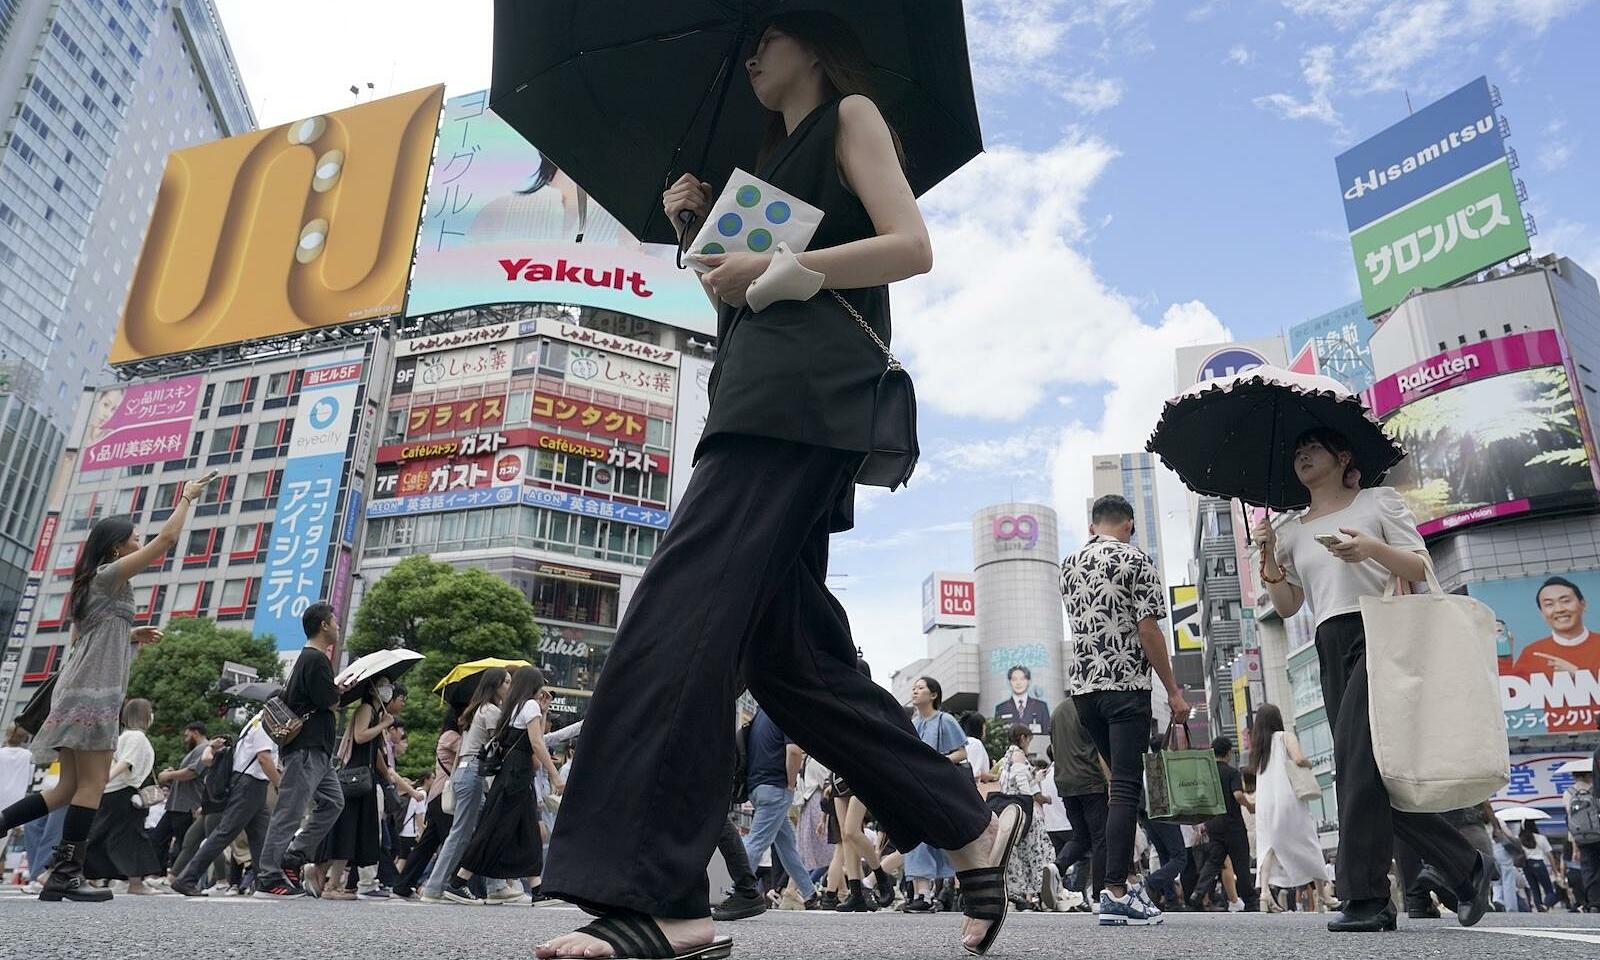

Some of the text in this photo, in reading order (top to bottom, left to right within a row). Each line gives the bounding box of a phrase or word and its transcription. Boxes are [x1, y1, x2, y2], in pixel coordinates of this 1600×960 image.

[434, 89, 487, 252] ヨーグルト
[1344, 115, 1494, 199] Hisamitsu
[1364, 193, 1511, 286] サロンパス
[498, 258, 653, 297] Yakult
[561, 324, 674, 362] しゃぶしゃぶバイキング
[397, 368, 415, 383] 9F
[449, 350, 507, 376] しゃぶ葉
[605, 360, 671, 392] しゃぶ葉
[1397, 354, 1480, 393] Rakuten
[141, 384, 196, 404] 品川スキン
[138, 400, 186, 419] クリニック
[410, 400, 502, 430] プライス
[532, 395, 642, 435] コンタクト
[96, 434, 182, 462] 品川美容外科
[459, 432, 508, 456] ガスト
[607, 447, 658, 472] ガスト
[377, 474, 399, 492] 7F
[428, 462, 488, 493] ガスト
[407, 492, 492, 512] 英会話イーオン
[527, 489, 562, 504] AEON
[569, 496, 667, 524] 英会話イーオン
[992, 514, 1039, 550] 109
[267, 481, 312, 619] アイシティ
[291, 478, 332, 618] コンタクトの
[944, 584, 969, 598] UNI
[944, 599, 972, 613] QLO
[1503, 709, 1600, 729] ンラインクリ
